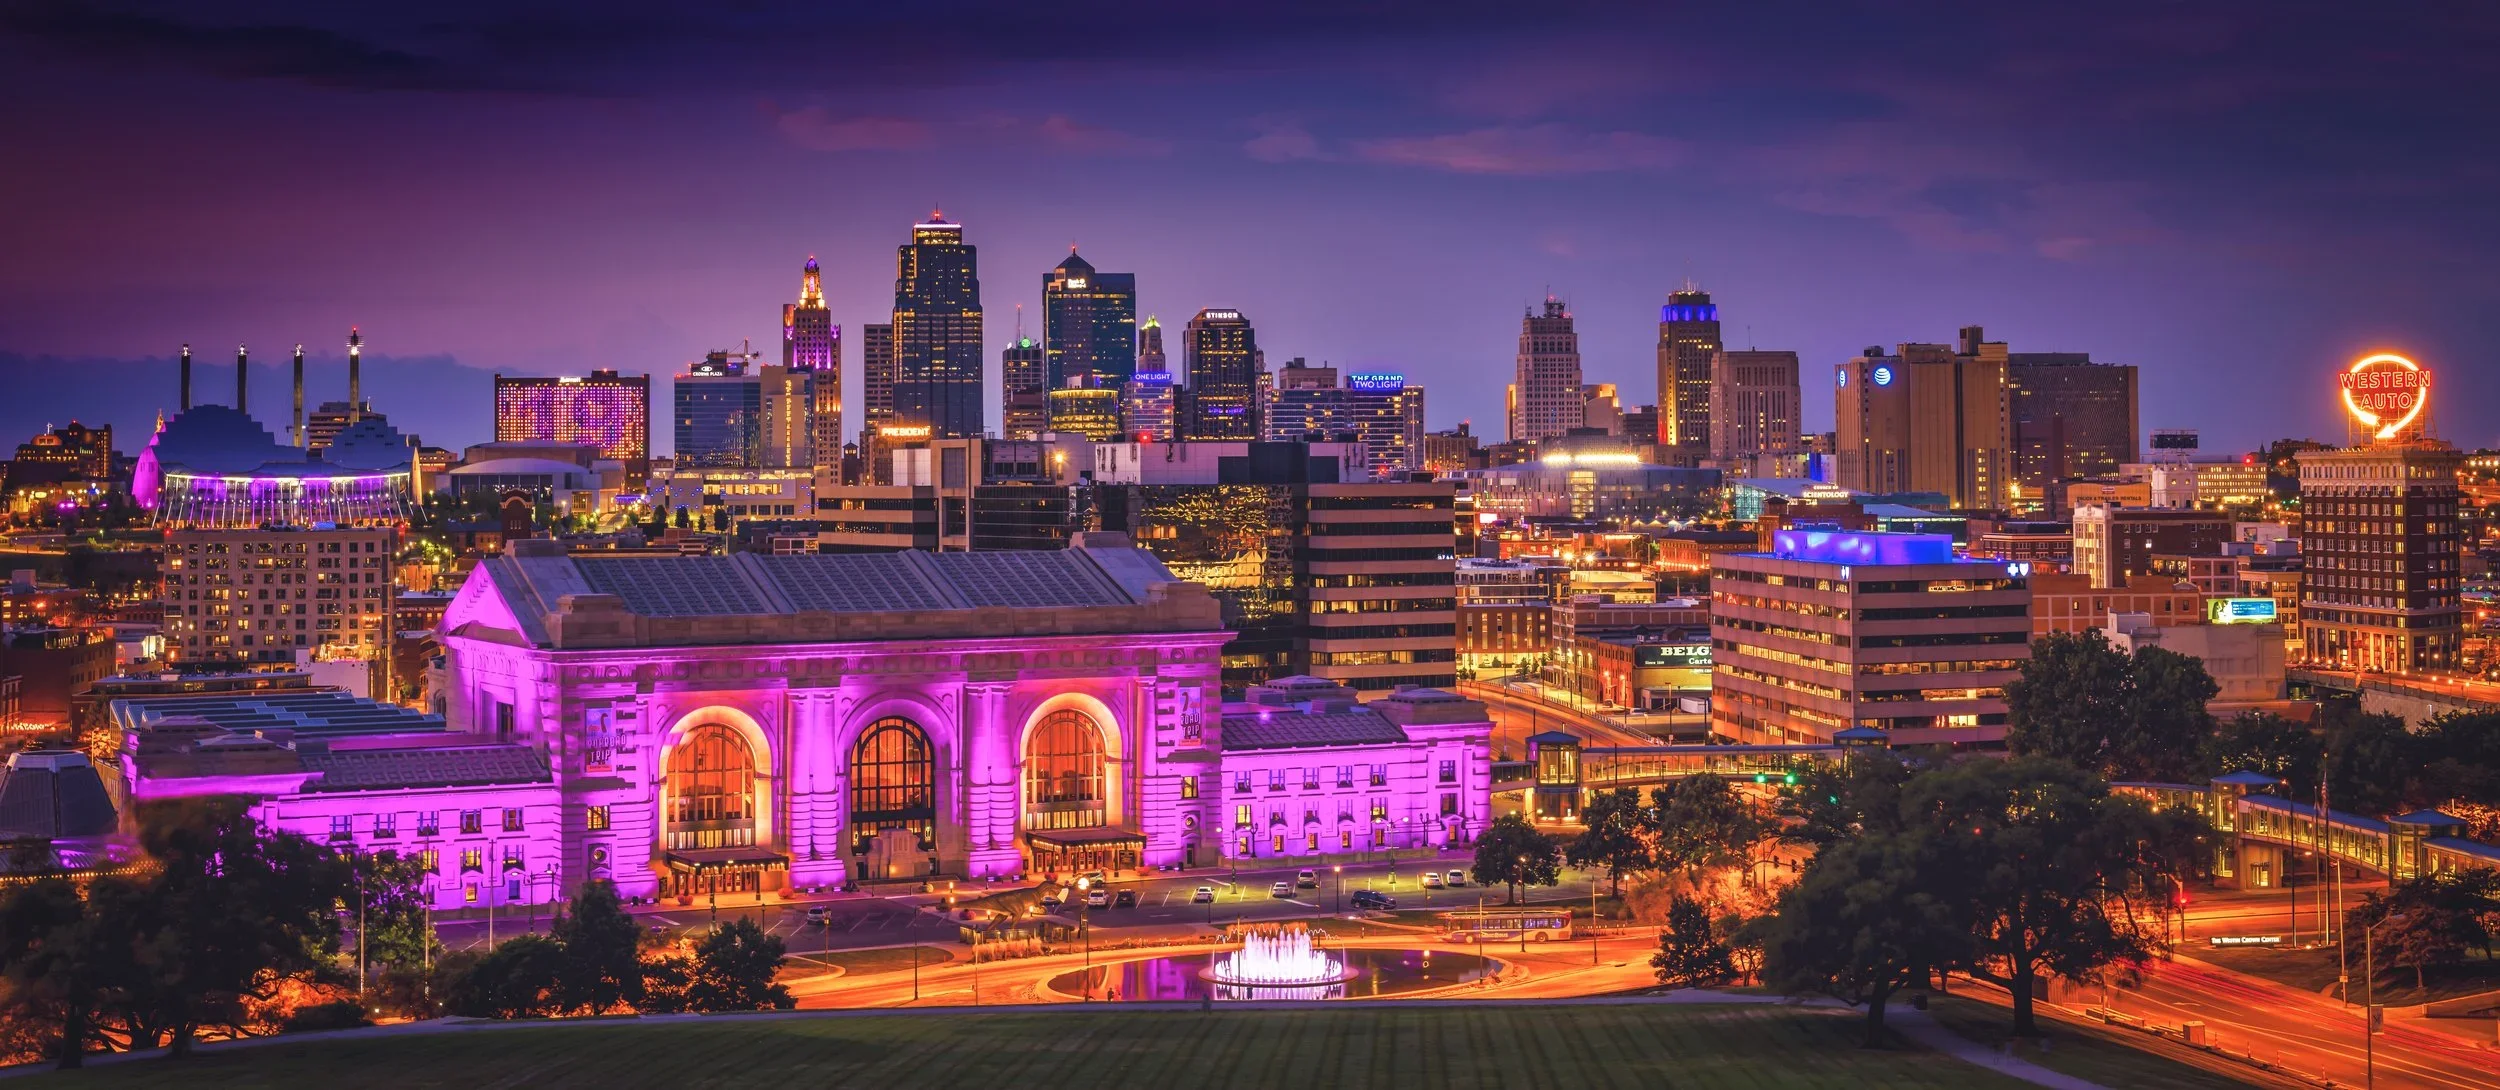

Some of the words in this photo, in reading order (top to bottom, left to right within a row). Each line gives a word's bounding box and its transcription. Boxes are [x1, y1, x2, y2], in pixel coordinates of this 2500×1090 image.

[2340, 371, 2431, 389] WESTERN
[2361, 392, 2413, 409] AUTO
[882, 426, 931, 436] PRESIDENT
[1660, 646, 1712, 656] BELG
[1183, 725, 1200, 737] TRIP
[591, 749, 610, 763] TRIP
